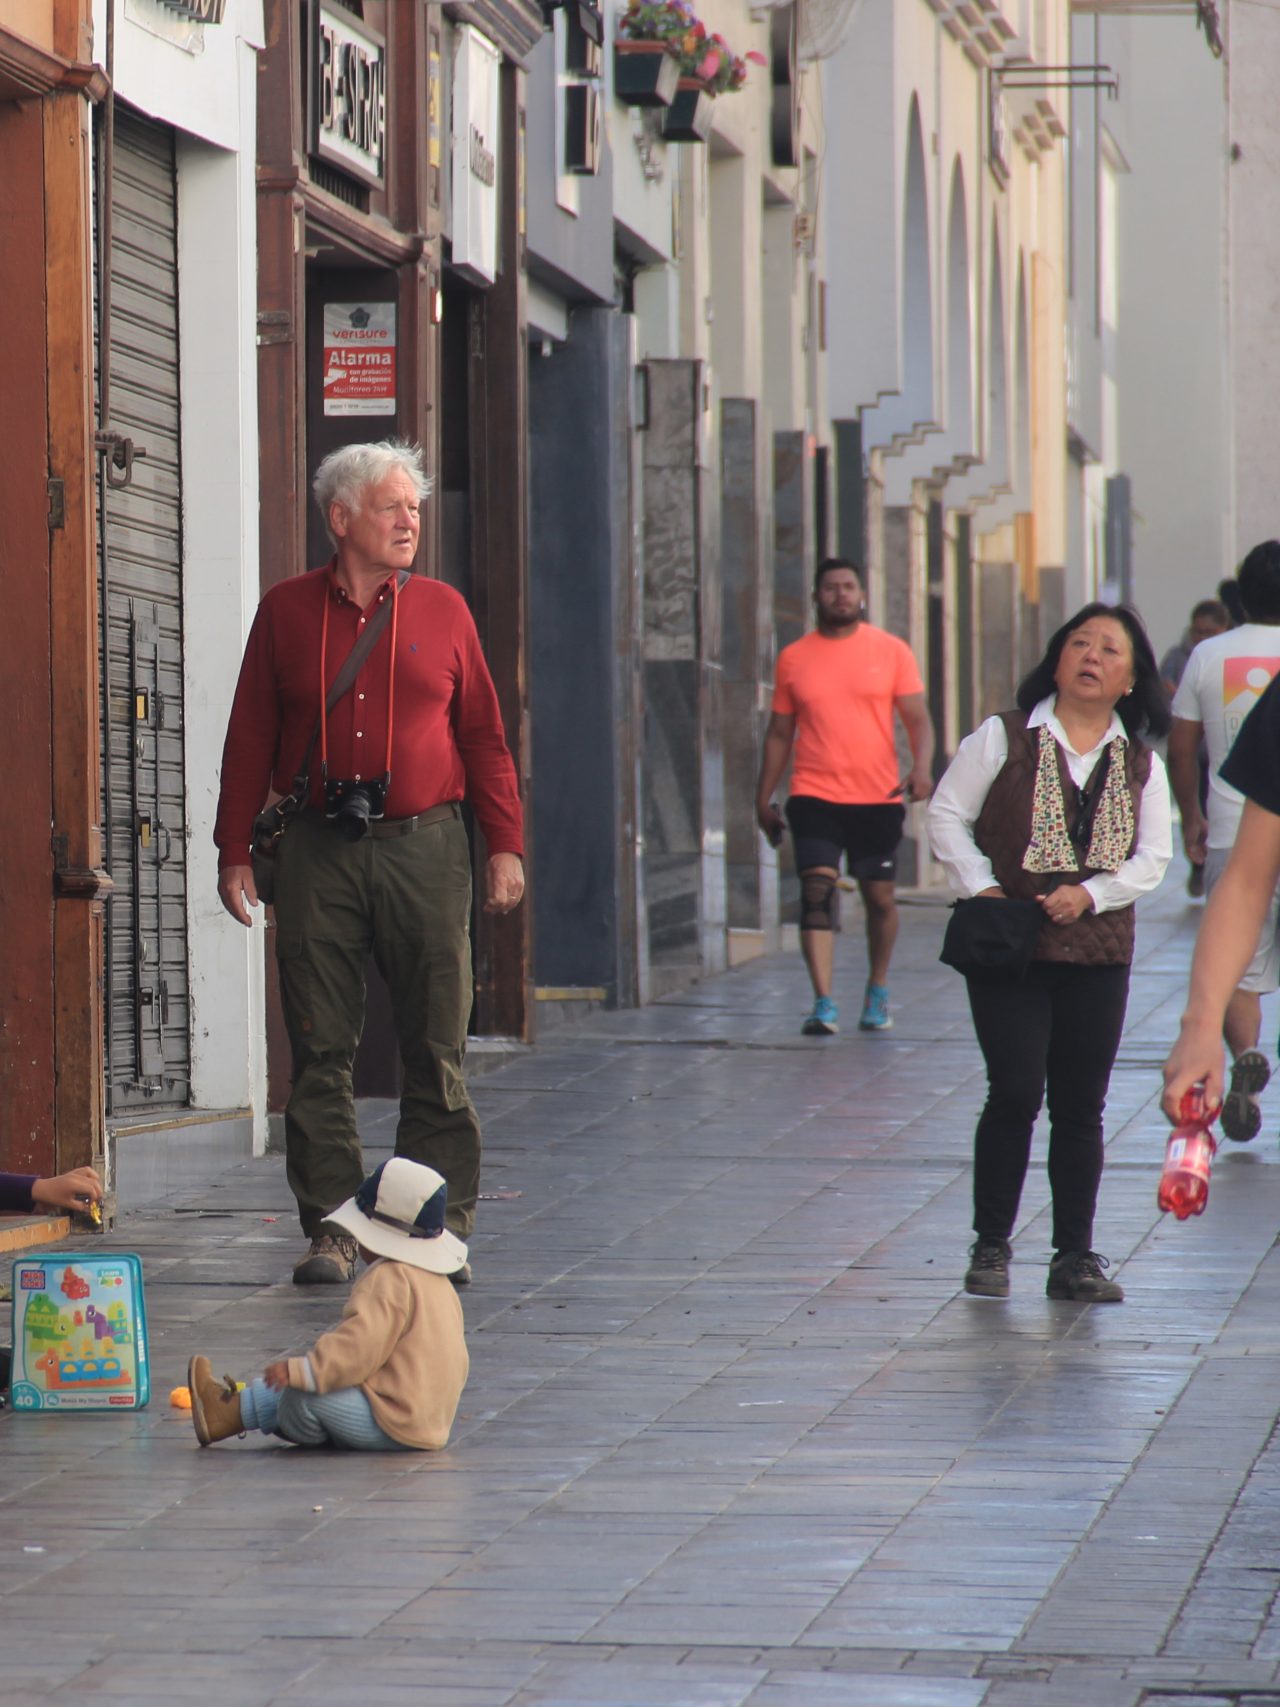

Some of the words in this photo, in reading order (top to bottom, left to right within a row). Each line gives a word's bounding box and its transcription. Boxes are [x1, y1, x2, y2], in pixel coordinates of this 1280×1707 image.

[332, 329, 388, 339] verisure
[328, 350, 392, 366] Alarma
[15, 1394, 33, 1407] 40
